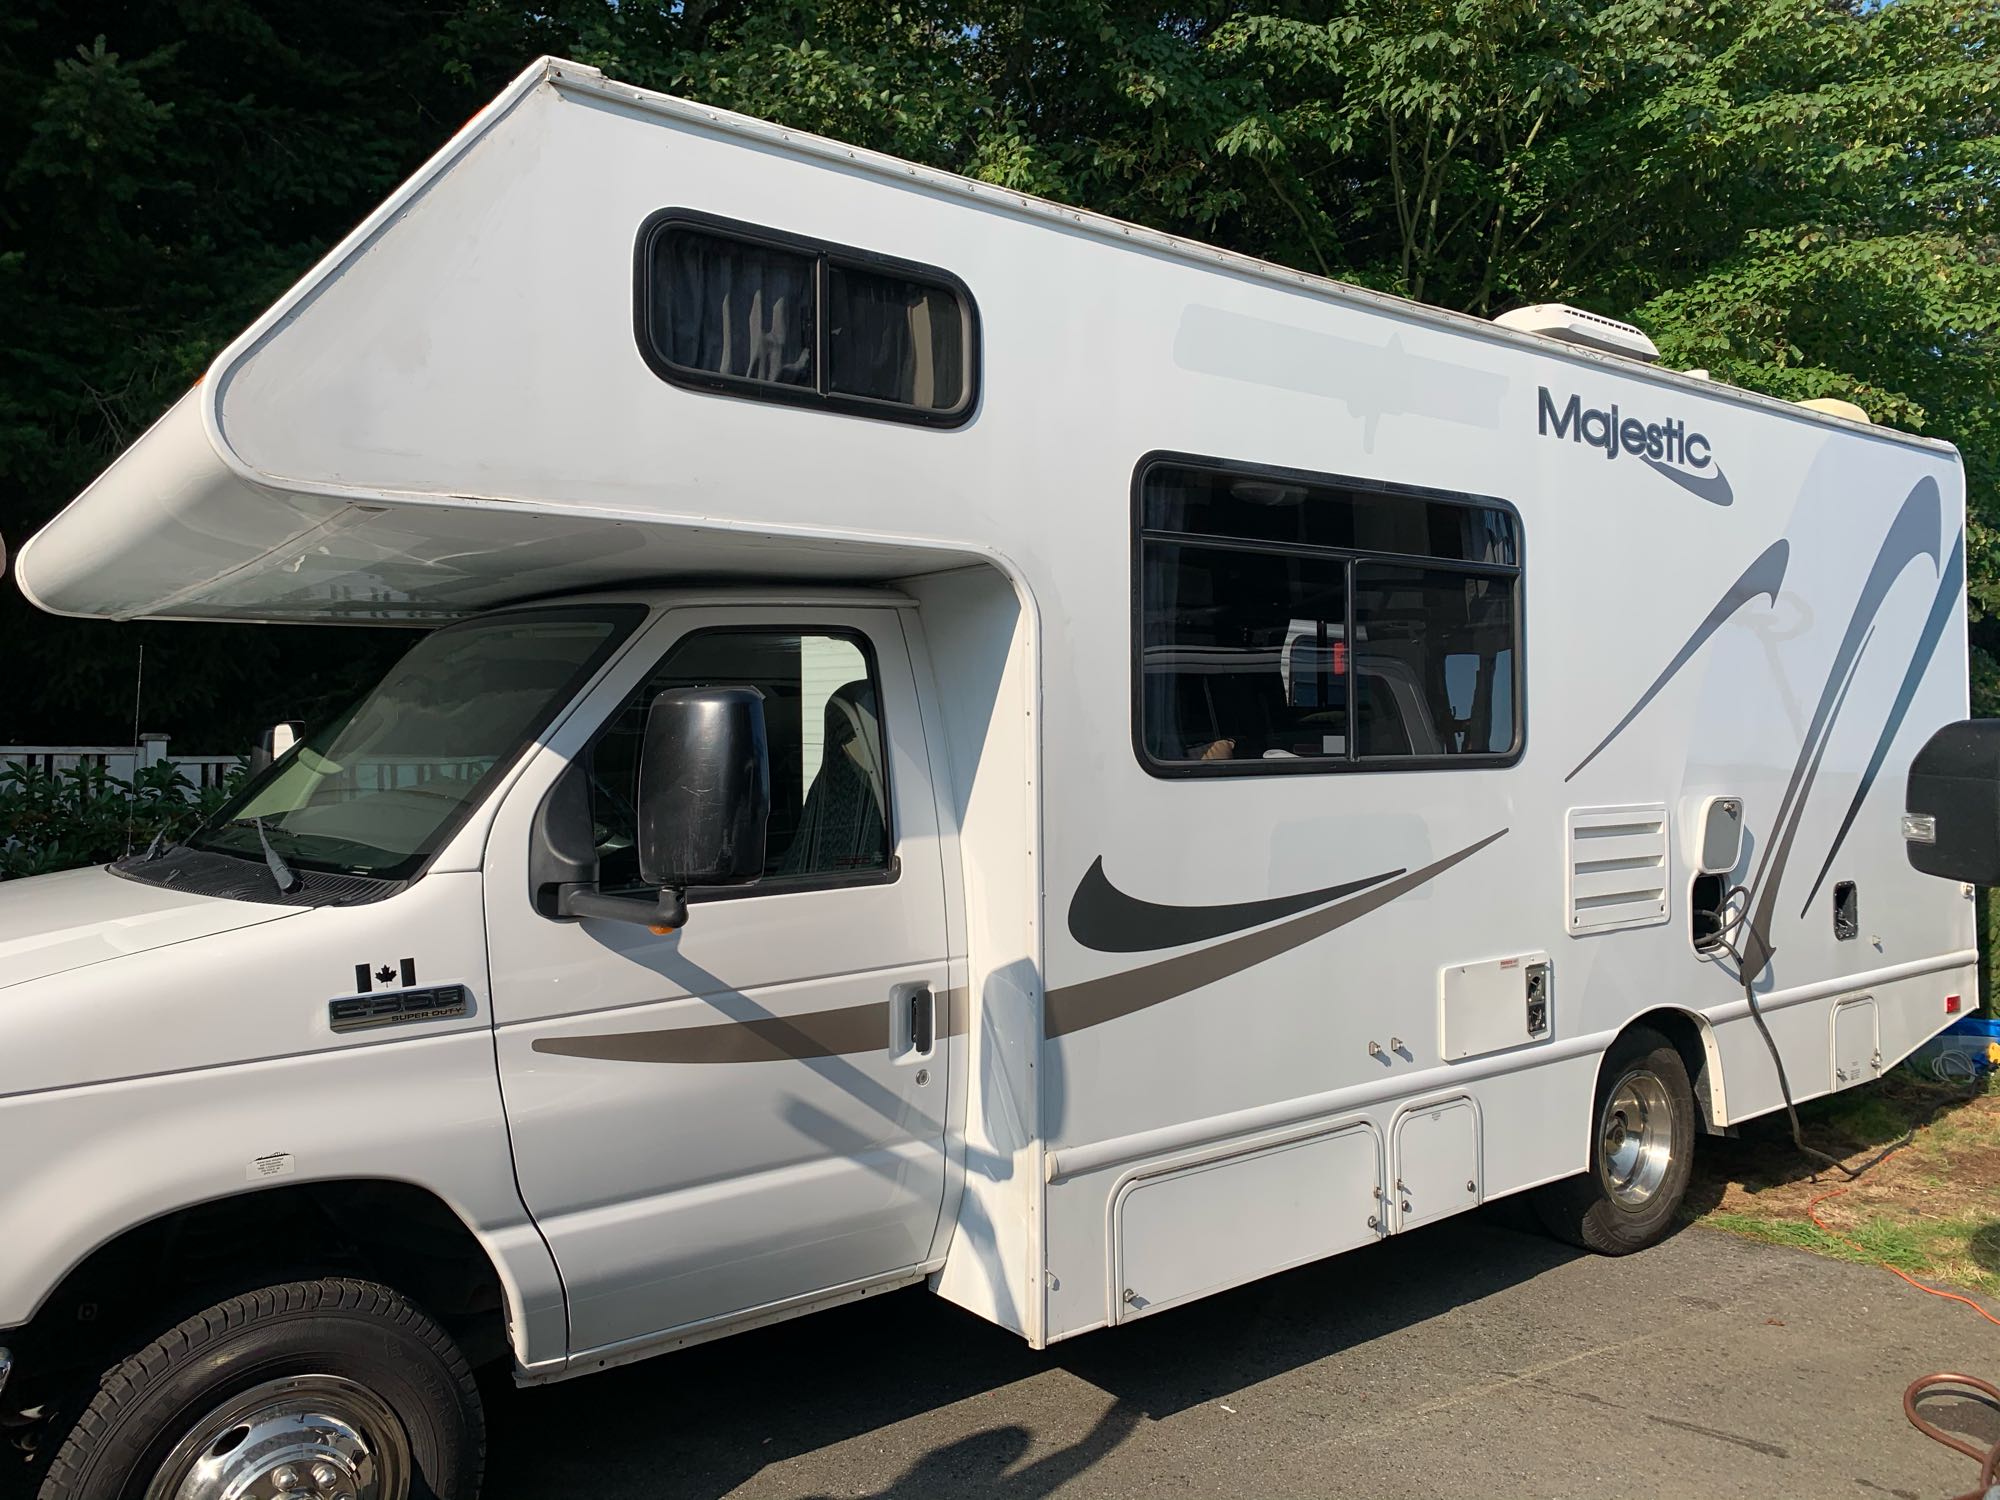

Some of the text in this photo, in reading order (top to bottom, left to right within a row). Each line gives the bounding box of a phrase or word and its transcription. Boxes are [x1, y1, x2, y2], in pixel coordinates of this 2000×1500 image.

[1538, 385, 1712, 469] Majestic
[391, 1007, 463, 1022] SUPER DUTY
